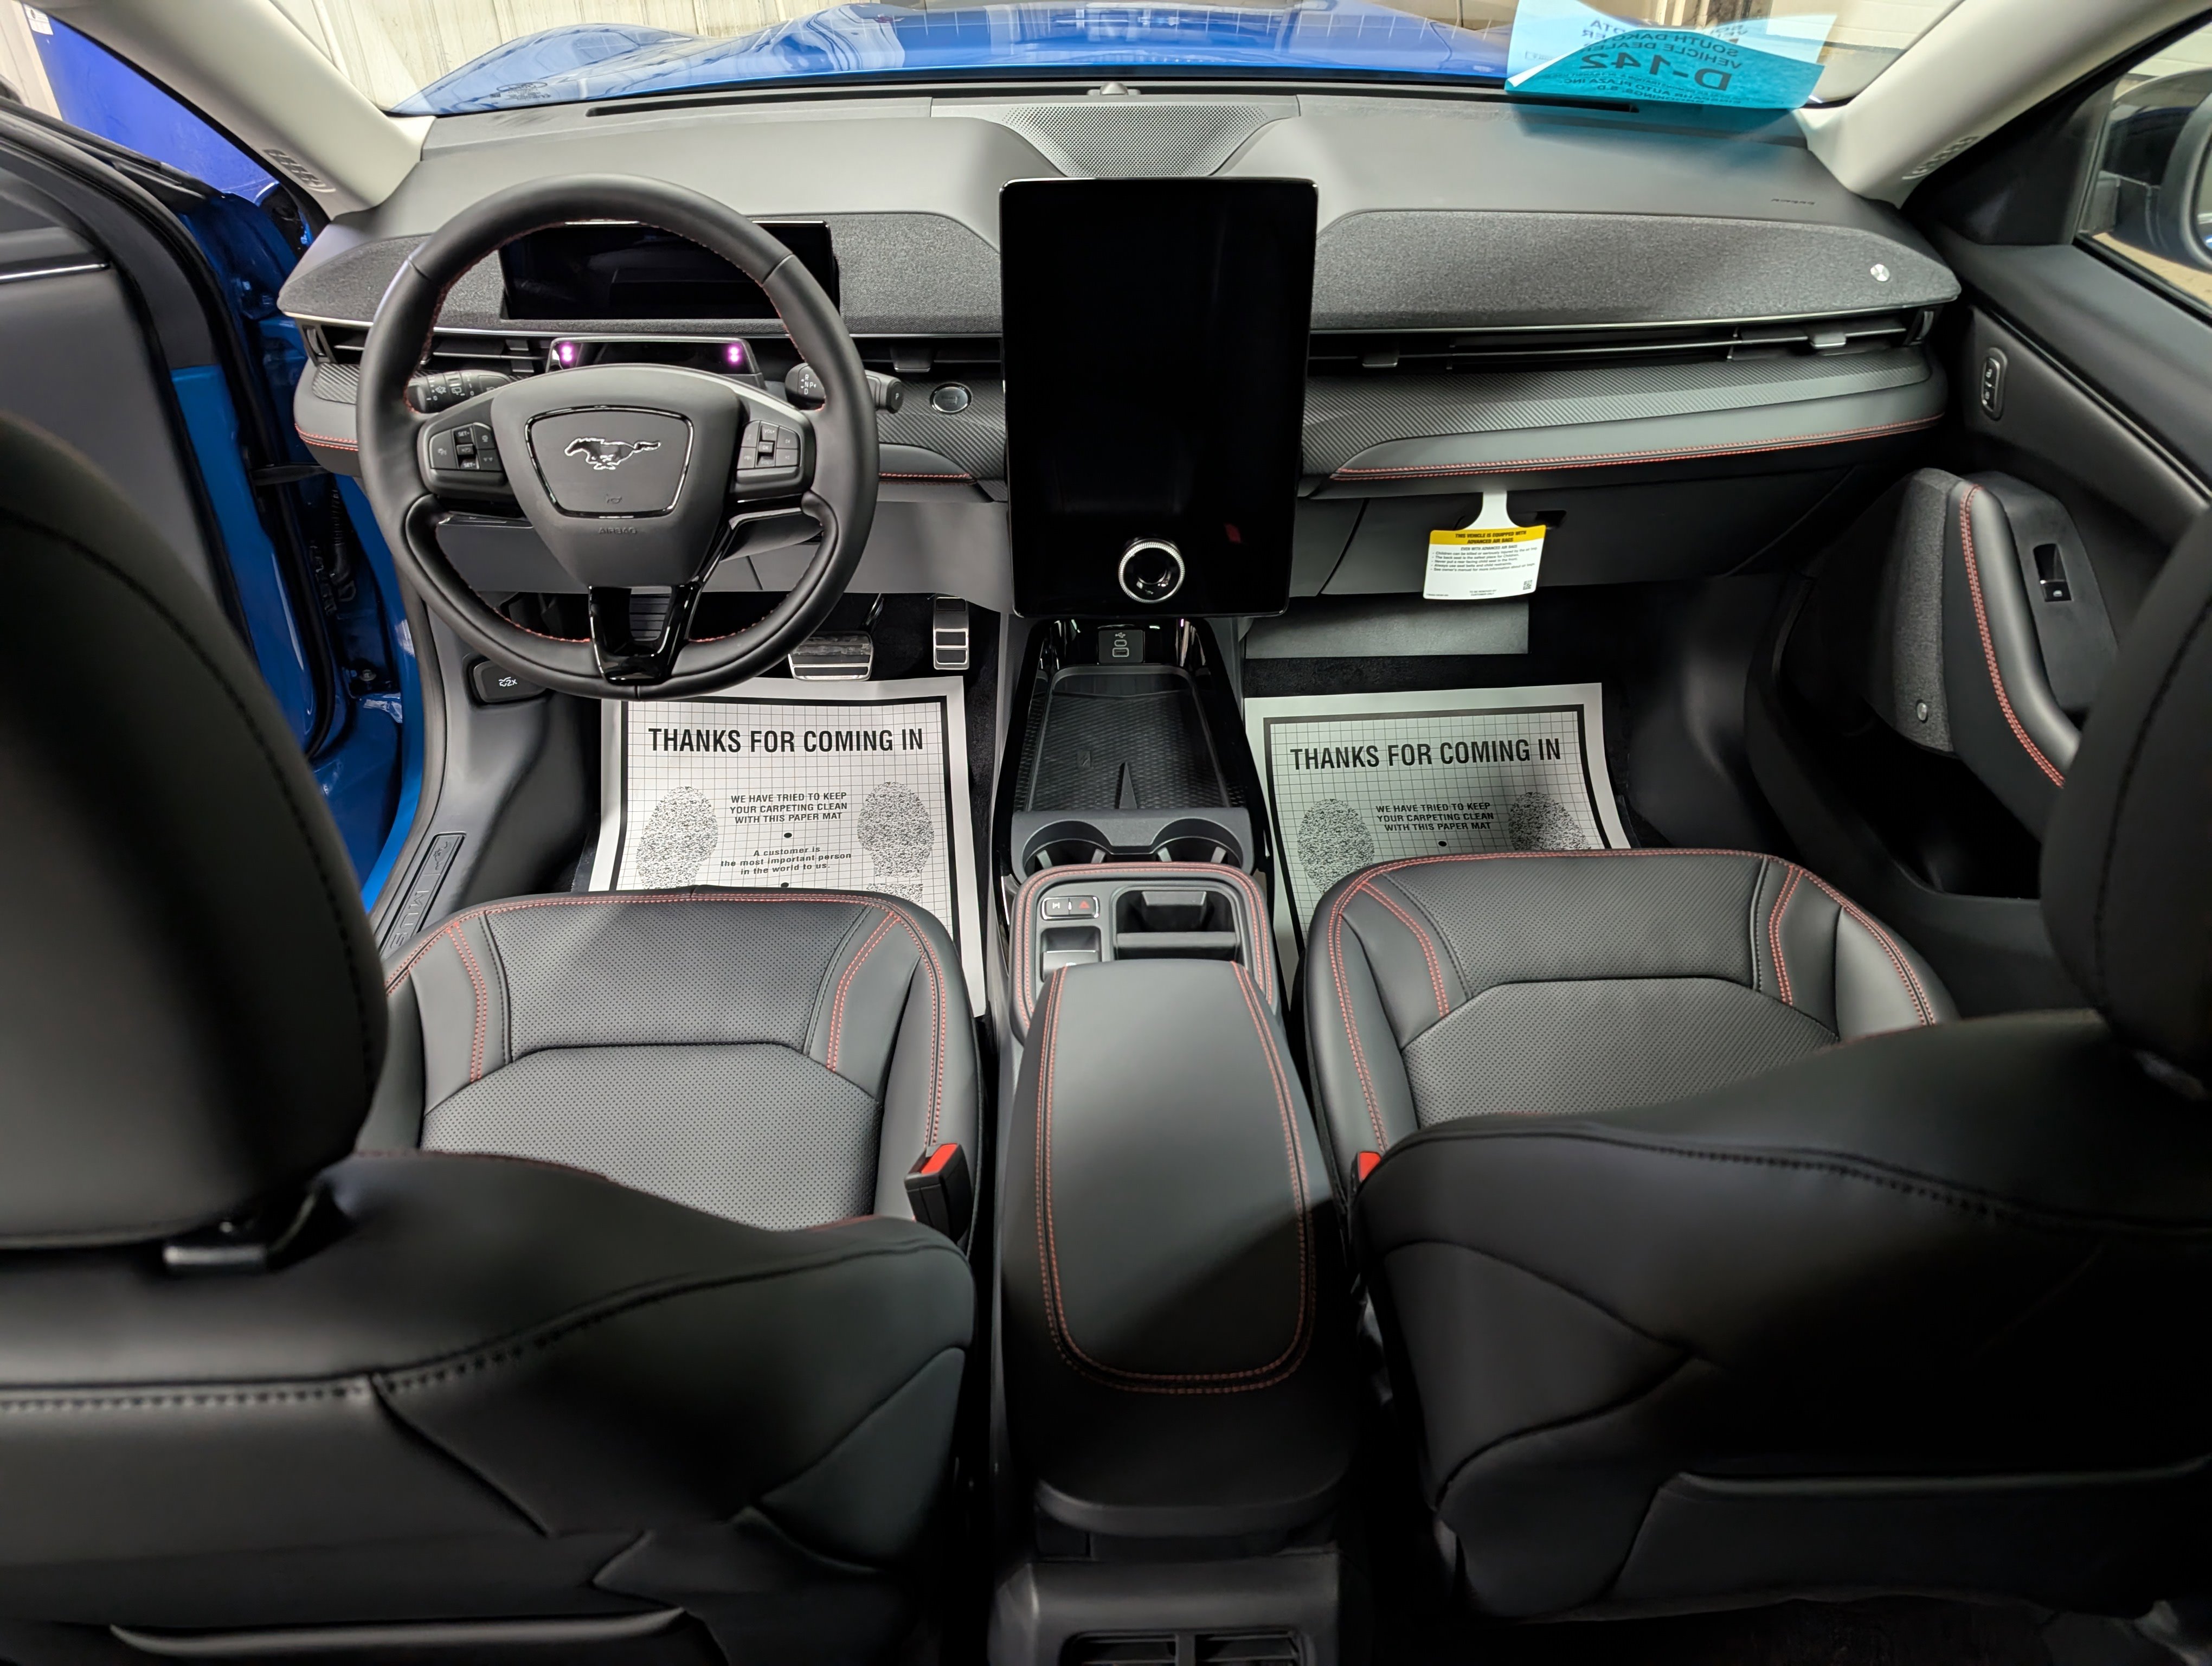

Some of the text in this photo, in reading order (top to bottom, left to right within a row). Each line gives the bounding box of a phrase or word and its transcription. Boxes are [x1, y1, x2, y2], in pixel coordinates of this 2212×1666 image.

[648, 728, 923, 753] THANKS FOR COMING IN
[1290, 738, 1561, 770] THANKS FOR COMING IN
[731, 795, 745, 803] WE
[749, 794, 773, 803] HAVE
[777, 793, 804, 802] TRIED
[730, 806, 756, 814] YOUR
[760, 804, 813, 812] CARPETING
[763, 847, 808, 856] customer
[768, 855, 814, 864] important
[773, 864, 799, 873] world
